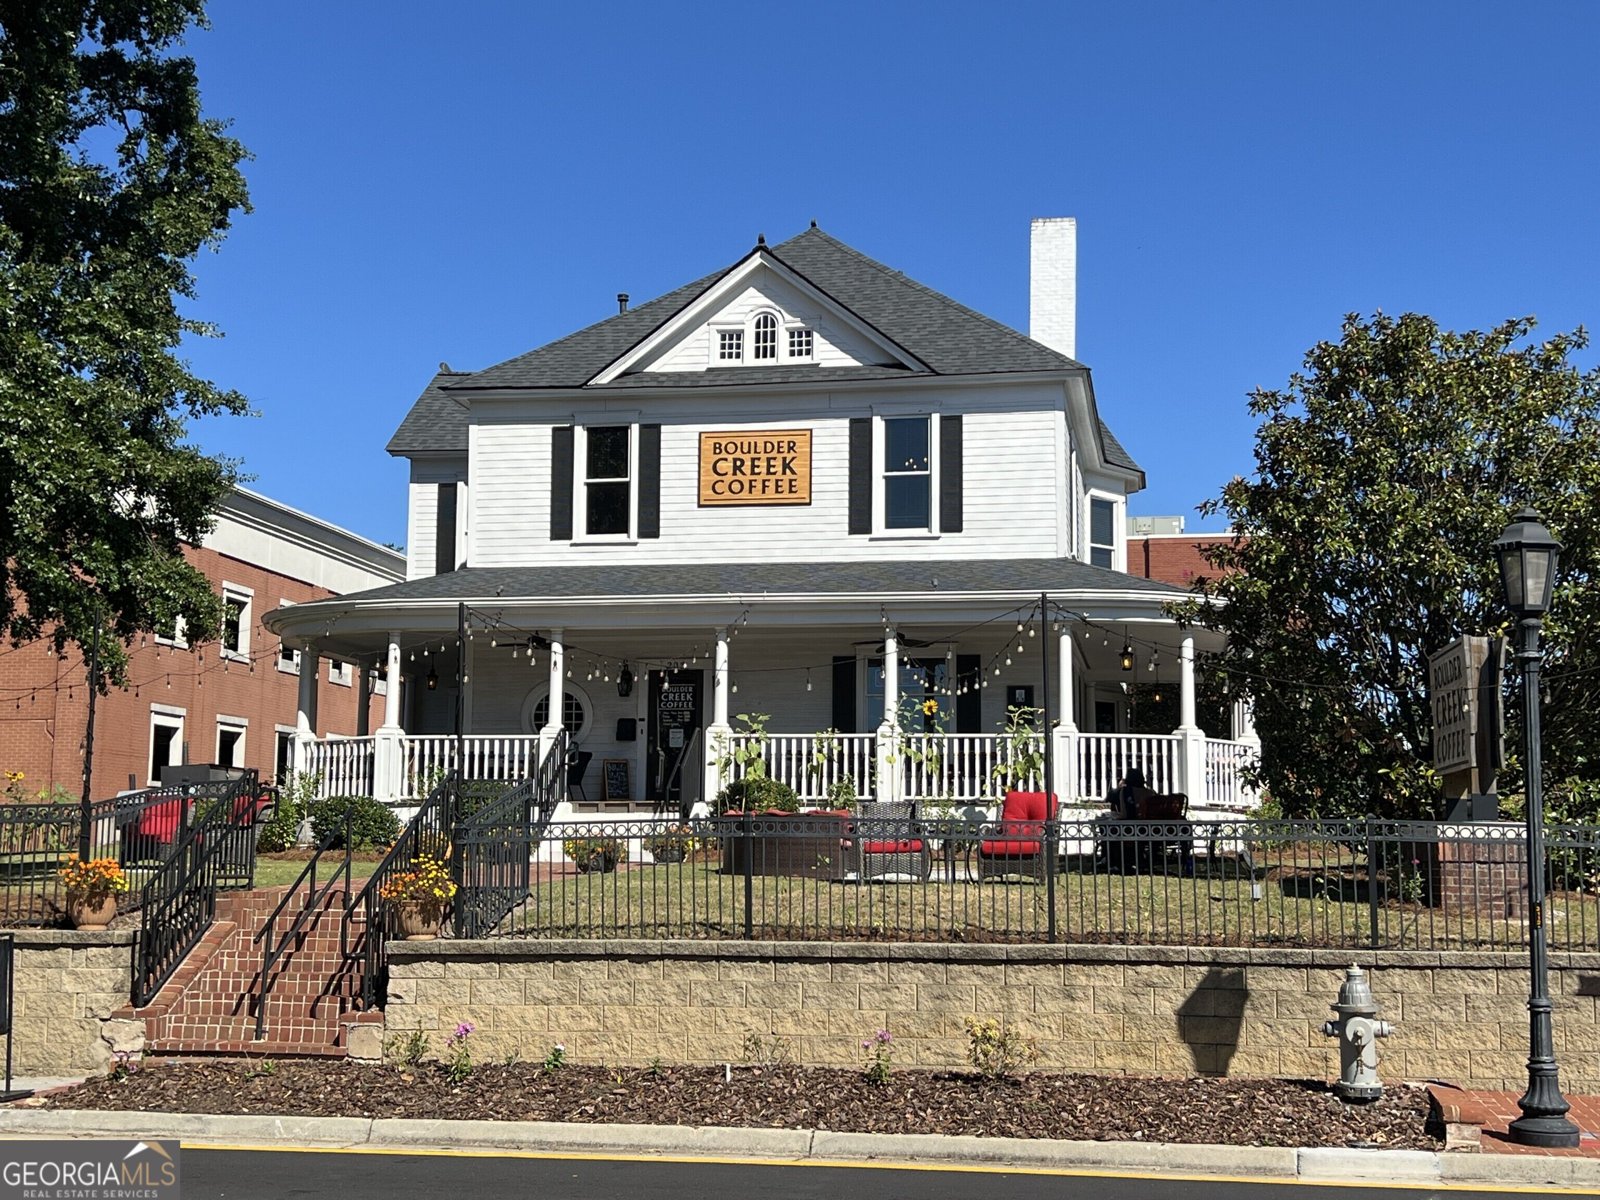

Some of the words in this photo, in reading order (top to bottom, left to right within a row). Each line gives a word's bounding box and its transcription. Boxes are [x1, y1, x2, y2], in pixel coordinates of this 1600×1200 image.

[713, 440, 797, 455] BOULDER
[712, 456, 798, 476] CREEK
[711, 479, 798, 495] COFFEE
[1434, 655, 1463, 690] BOULDER
[661, 693, 693, 701] CREEK
[1436, 688, 1466, 729] CREEK
[1437, 729, 1466, 764] COFFEE
